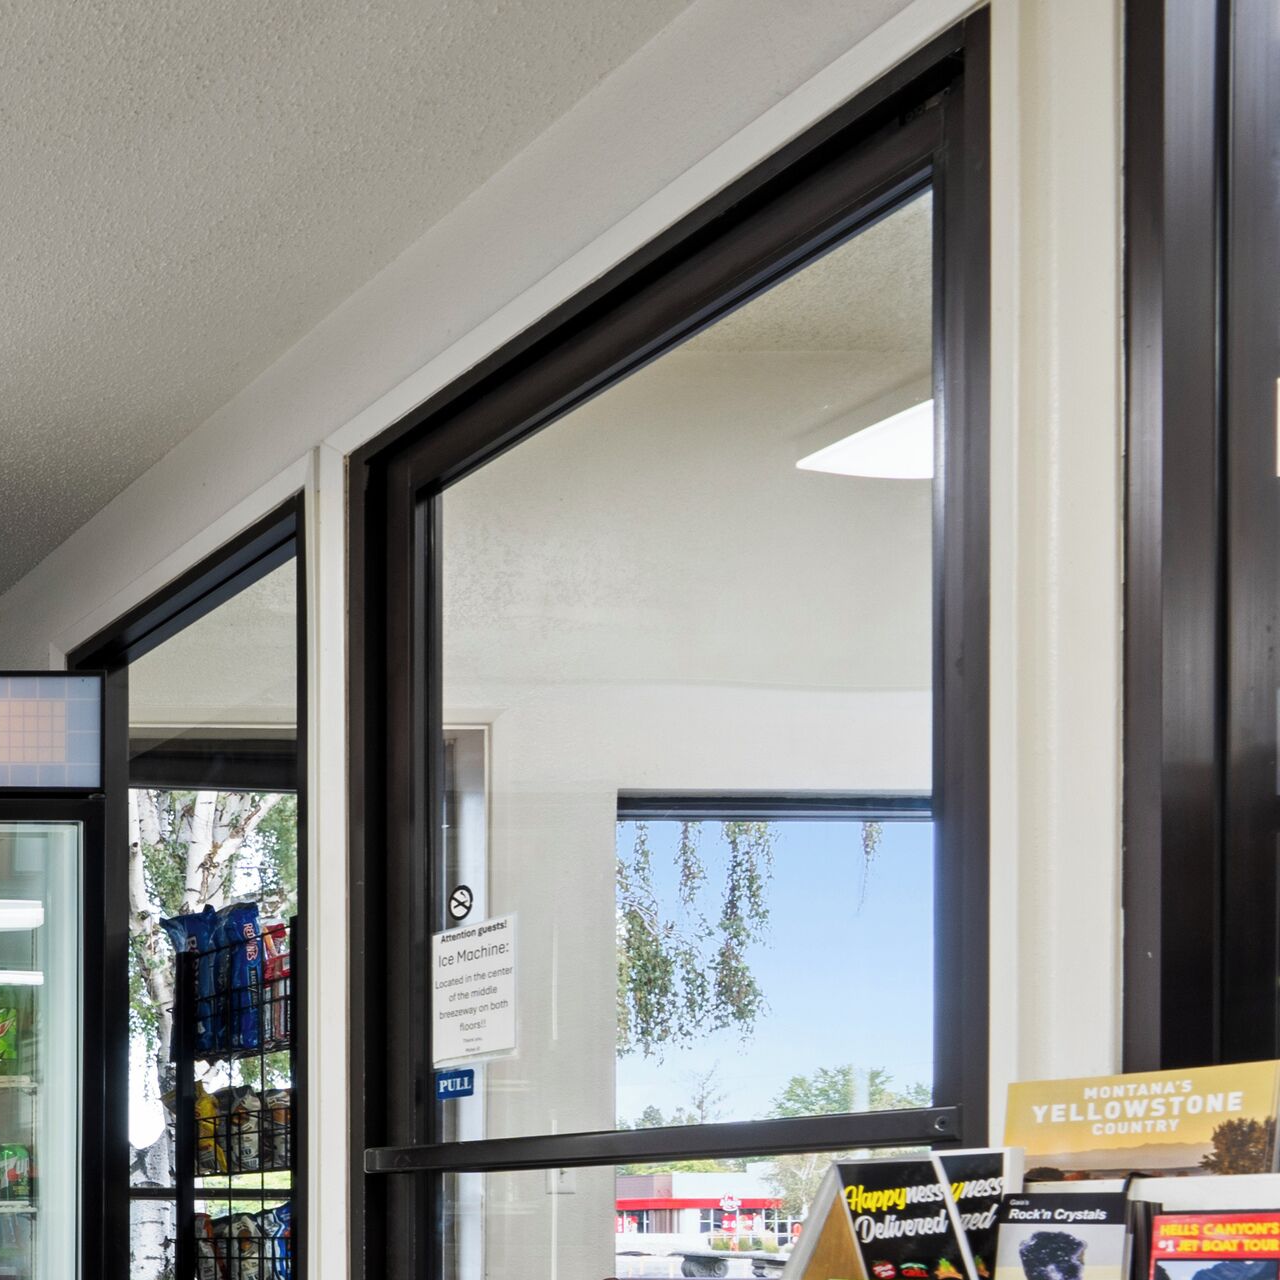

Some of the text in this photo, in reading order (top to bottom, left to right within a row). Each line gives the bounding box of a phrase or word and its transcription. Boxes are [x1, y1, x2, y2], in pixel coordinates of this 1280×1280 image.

[440, 920, 508, 944] Attention guests!
[438, 942, 510, 968] Ice Machine:
[435, 966, 513, 989] Located in the center
[449, 985, 498, 1002] of the middle
[439, 999, 508, 1020] breezeway on both
[460, 1020, 486, 1032] floors!!
[439, 1077, 471, 1092] PULL
[1083, 1079, 1193, 1100] MONTANA'S
[1032, 1091, 1243, 1123] YELLOWSTONE
[1092, 1119, 1180, 1136] COUNTRY
[843, 1183, 944, 1213] Happyness
[1009, 1208, 1107, 1221] Rock'n Crystals
[855, 1209, 948, 1243] Delivered
[1160, 1222, 1280, 1237] HELLS CANYON'S
[1158, 1238, 1279, 1252] #1 JET BOAT TOUR
